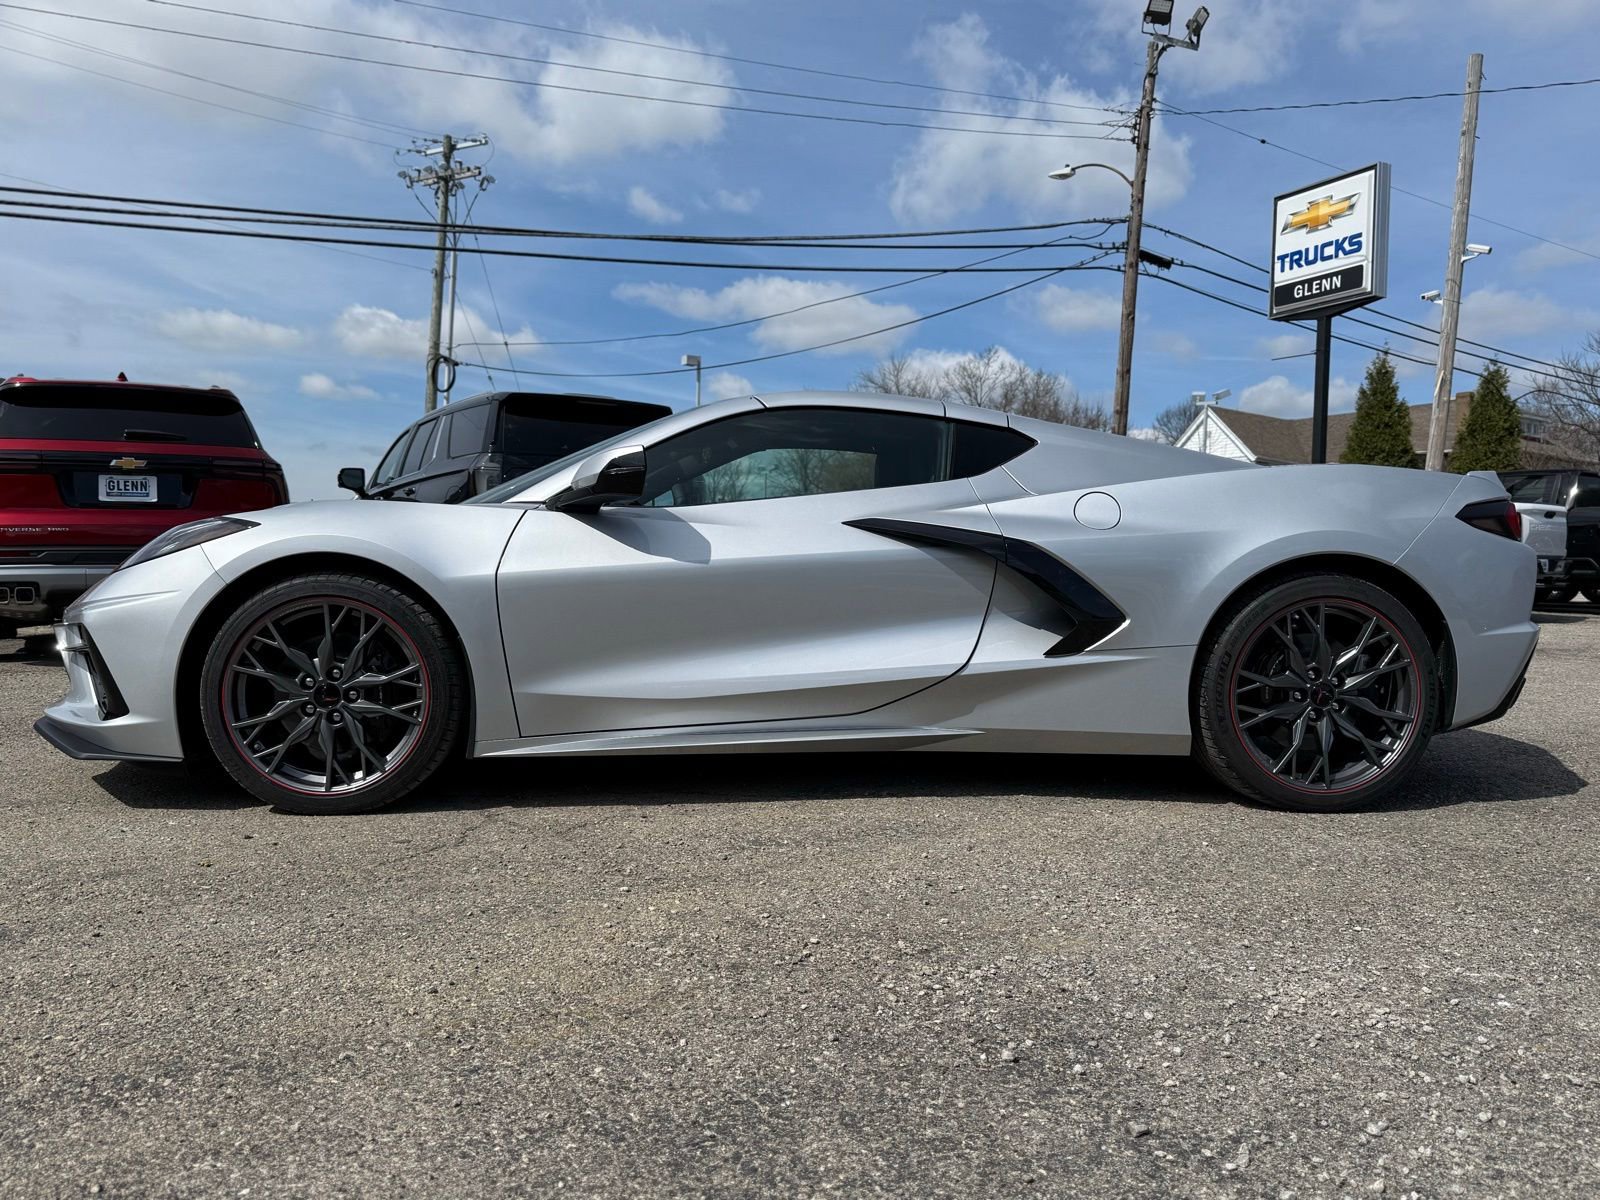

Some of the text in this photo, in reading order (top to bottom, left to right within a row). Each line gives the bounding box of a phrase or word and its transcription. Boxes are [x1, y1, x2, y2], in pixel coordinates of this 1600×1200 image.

[1276, 232, 1363, 273] TRUCKS
[1293, 275, 1341, 298] GLENN
[107, 479, 148, 492] GLENN
